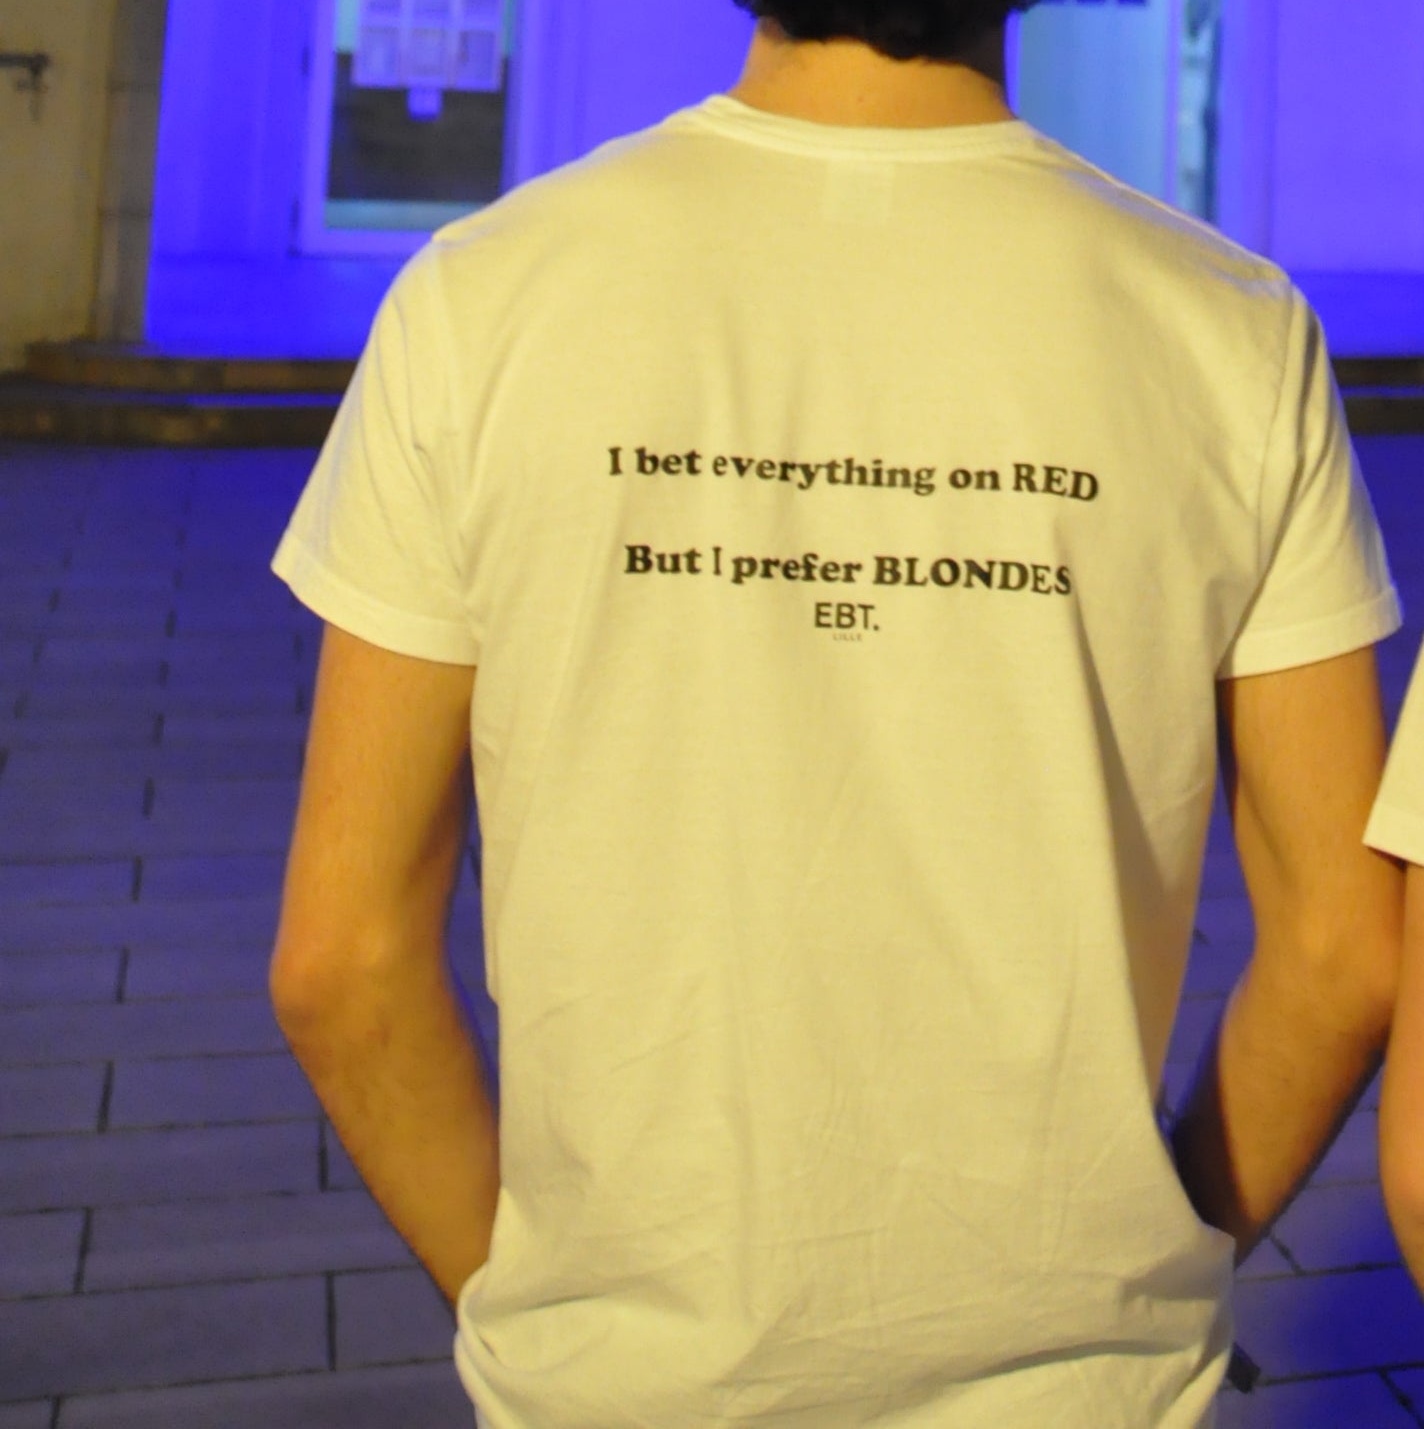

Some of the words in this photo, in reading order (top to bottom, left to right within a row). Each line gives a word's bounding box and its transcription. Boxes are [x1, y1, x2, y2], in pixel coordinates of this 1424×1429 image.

[607, 446, 624, 477] I
[634, 447, 701, 477] bet
[711, 455, 936, 496] everything
[948, 466, 1002, 491] on
[1011, 462, 1100, 502] RED
[624, 543, 702, 575] But
[711, 546, 723, 576] I
[731, 552, 864, 585] prefer
[872, 554, 1072, 596] BLONDES
[813, 602, 881, 631] EBT.
